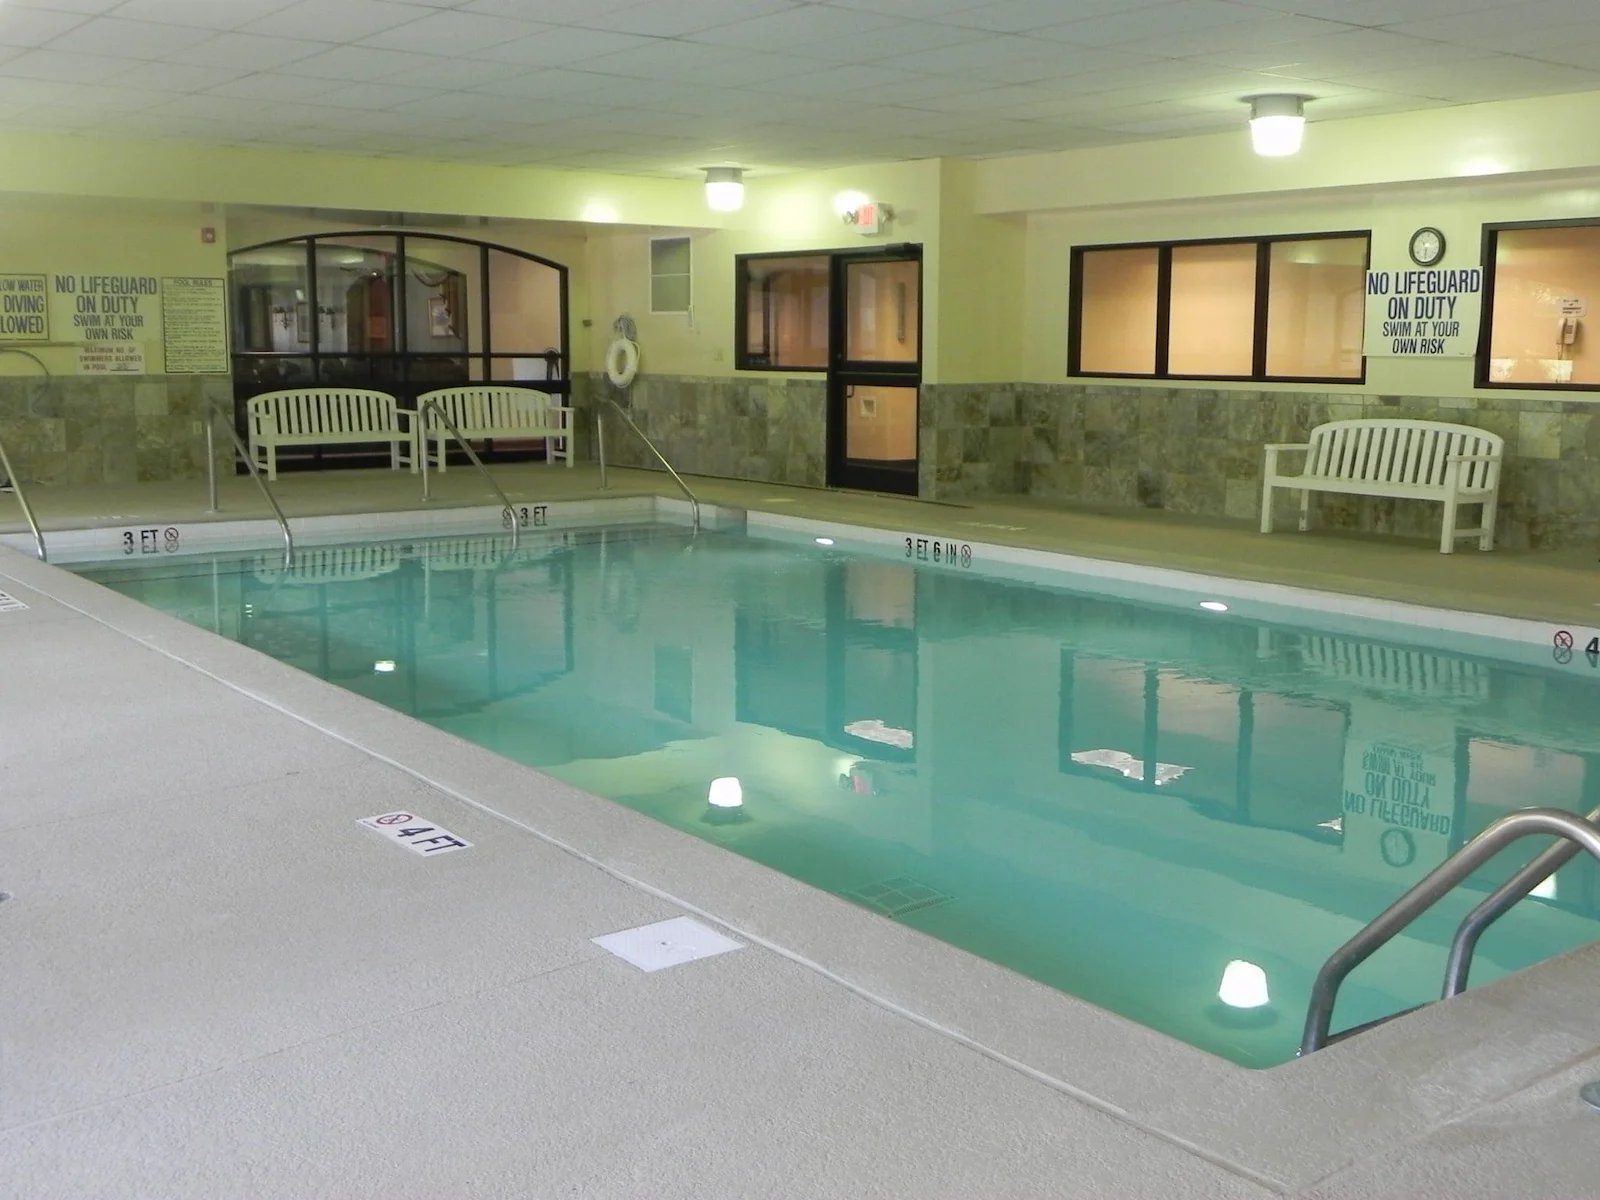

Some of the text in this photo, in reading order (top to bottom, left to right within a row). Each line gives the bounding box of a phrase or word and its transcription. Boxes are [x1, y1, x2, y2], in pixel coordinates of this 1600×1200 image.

[17, 279, 44, 292] WATER
[55, 275, 157, 295] NO LIFEGUARD
[1368, 269, 1480, 295] NO LIFEGUARD
[4, 295, 44, 313] DIVING
[76, 295, 139, 313] ON DUTY
[1388, 296, 1457, 319] ON DUTY
[73, 314, 144, 327] SWIM AT YOUR
[1382, 321, 1460, 337] SWIM AT YOUR
[85, 328, 134, 340] OWN RISK
[1392, 339, 1446, 354] OWN RISK
[533, 505, 548, 518] FT
[123, 529, 159, 546] 3 FT
[916, 538, 929, 552] FT
[933, 541, 941, 555] 6
[945, 542, 957, 556] IN
[1585, 636, 1600, 654] 4
[397, 827, 467, 853] 4 FT
